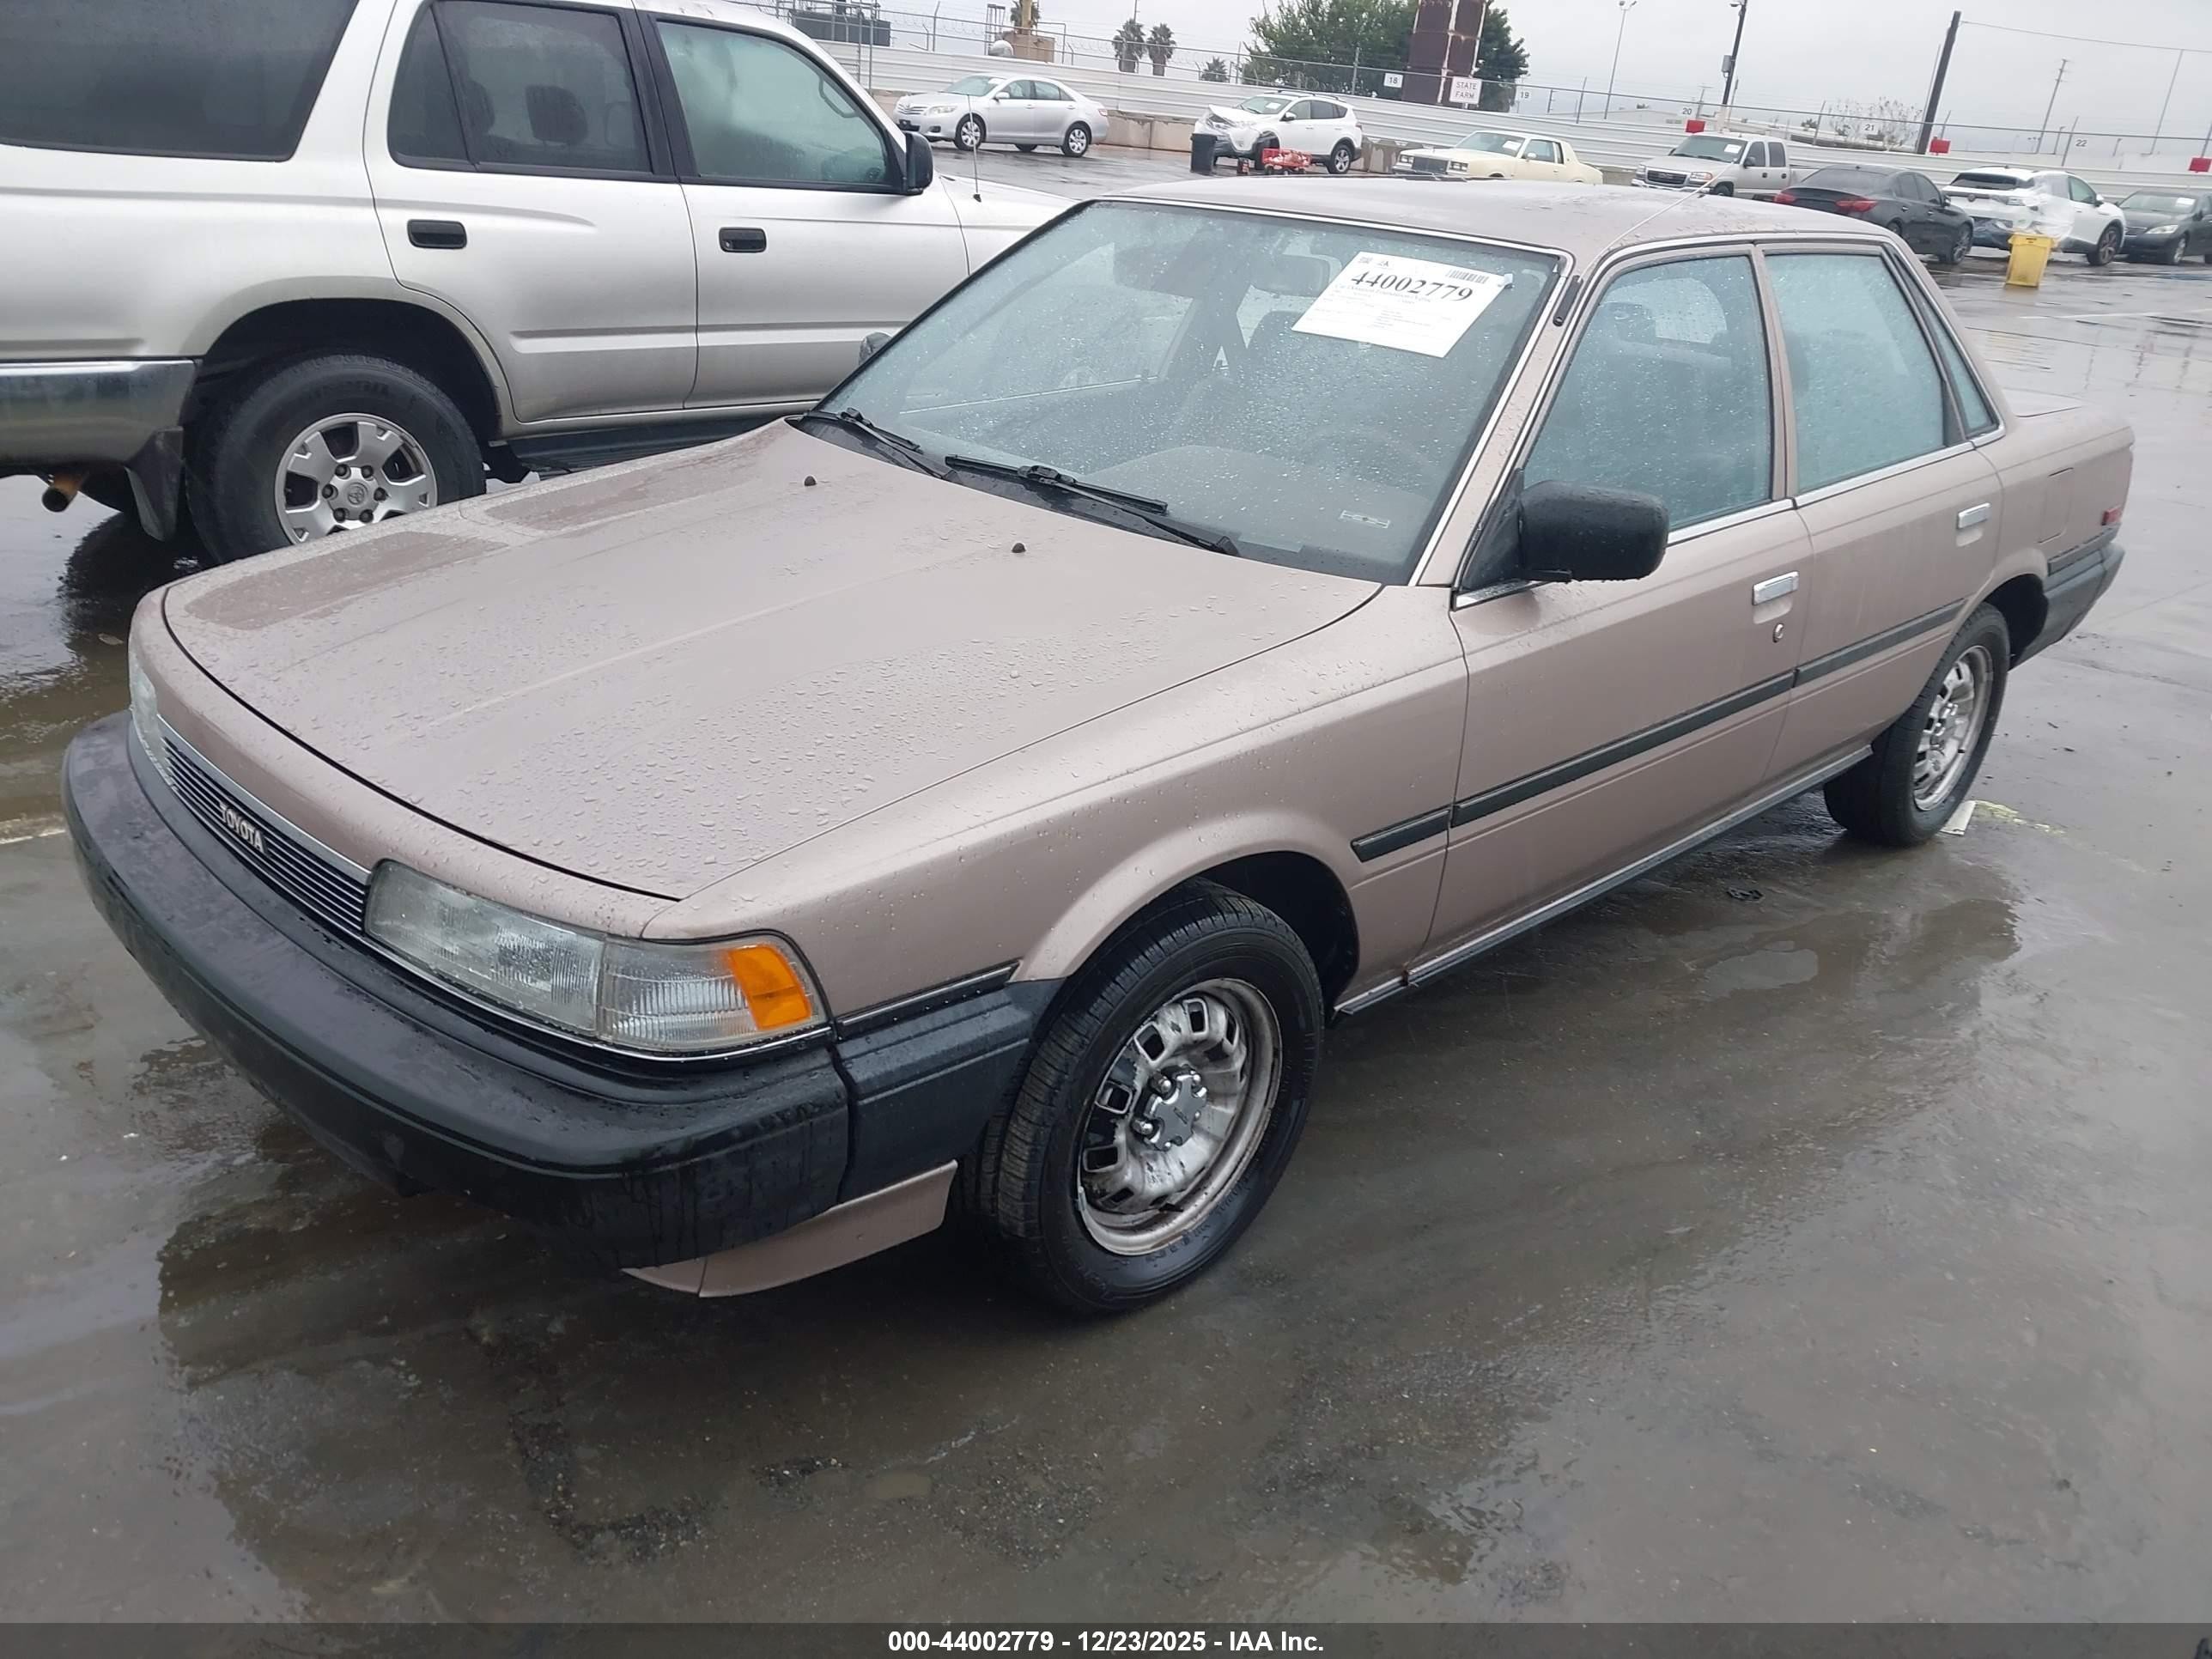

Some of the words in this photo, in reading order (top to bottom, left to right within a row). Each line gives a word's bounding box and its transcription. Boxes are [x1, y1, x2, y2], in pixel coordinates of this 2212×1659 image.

[1455, 82, 1478, 90] STATE
[1864, 123, 1875, 131] 21
[1351, 271, 1474, 301] 44002779
[218, 802, 264, 854] TOYOTA
